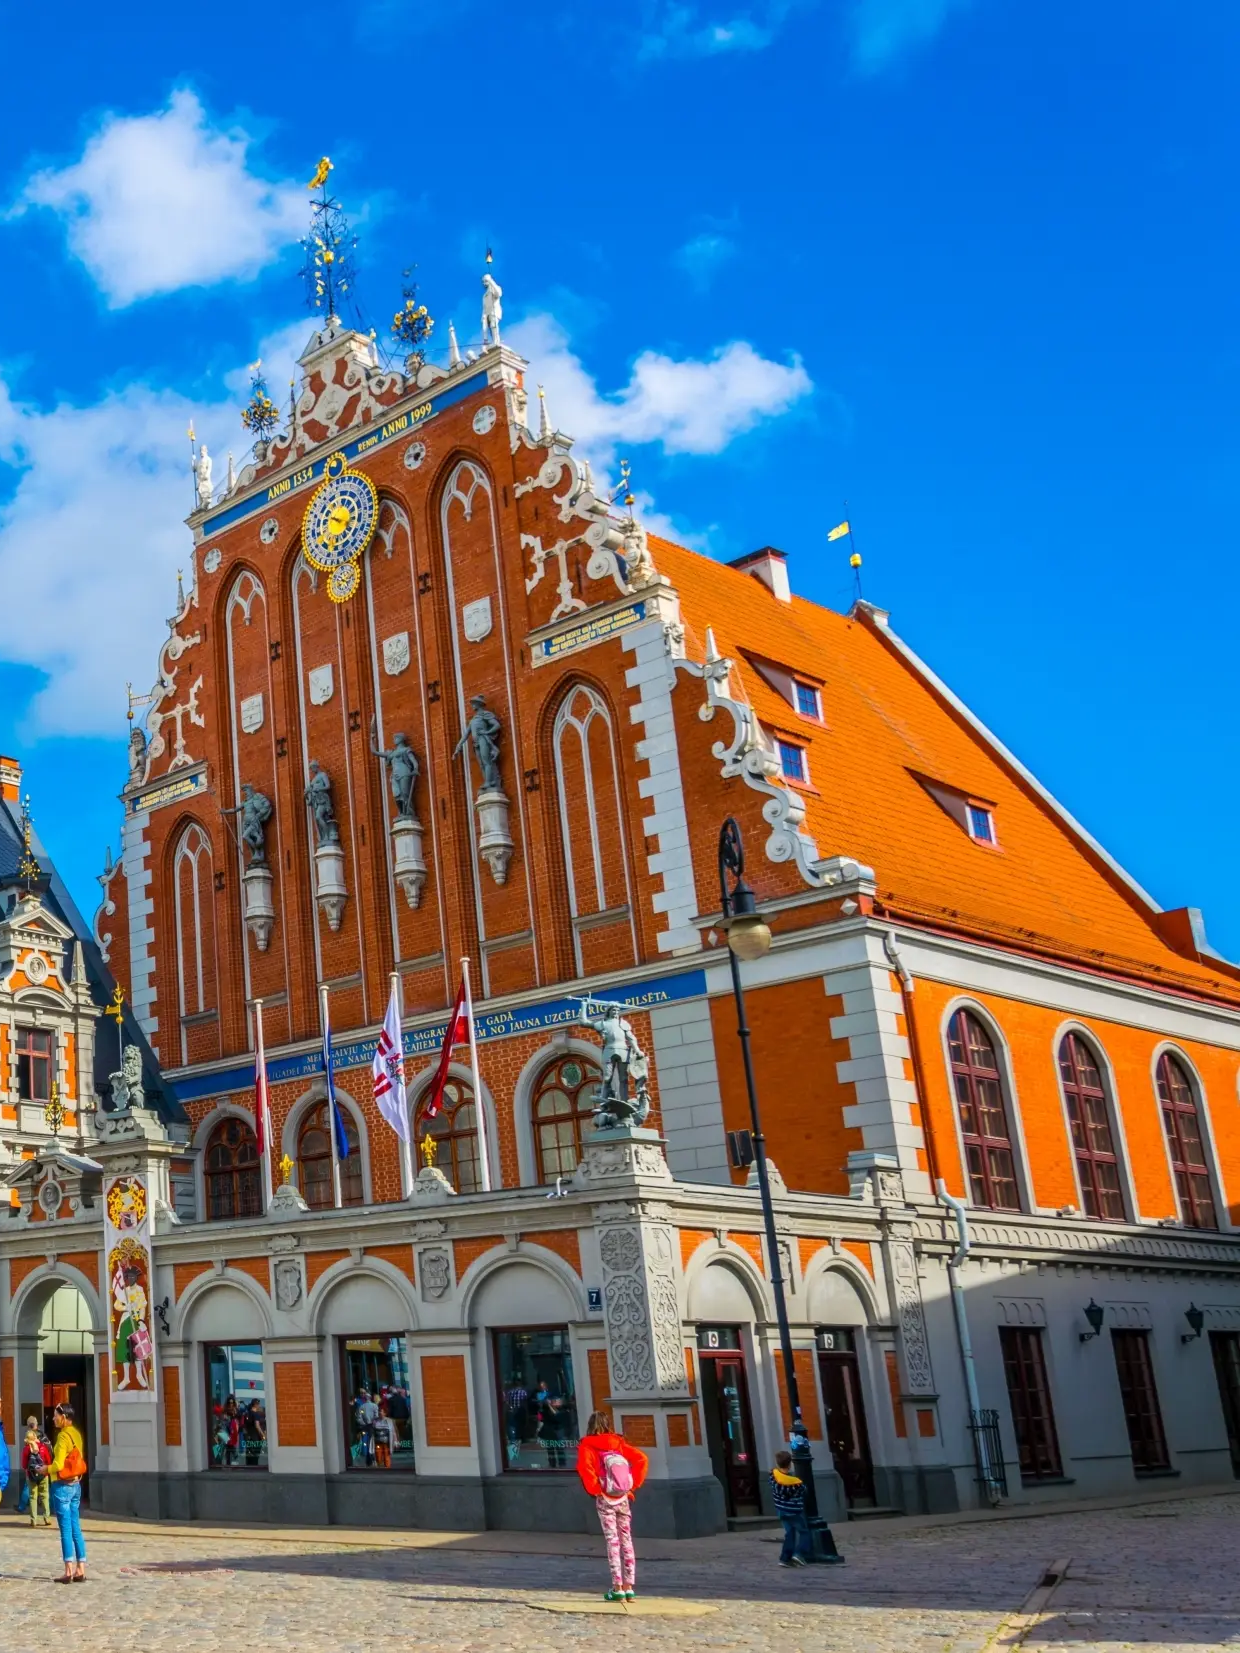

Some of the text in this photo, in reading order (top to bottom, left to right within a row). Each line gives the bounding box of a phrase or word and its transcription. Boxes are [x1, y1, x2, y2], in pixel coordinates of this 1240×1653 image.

[381, 415, 408, 440] ANNO
[410, 402, 433, 425] 1999
[268, 478, 291, 501] ANNO
[303, 1063, 317, 1074] PAR
[347, 1051, 374, 1065] NAMU
[490, 1024, 506, 1036] NO
[510, 1017, 541, 1033] JAUNA
[591, 1293, 596, 1303] 7
